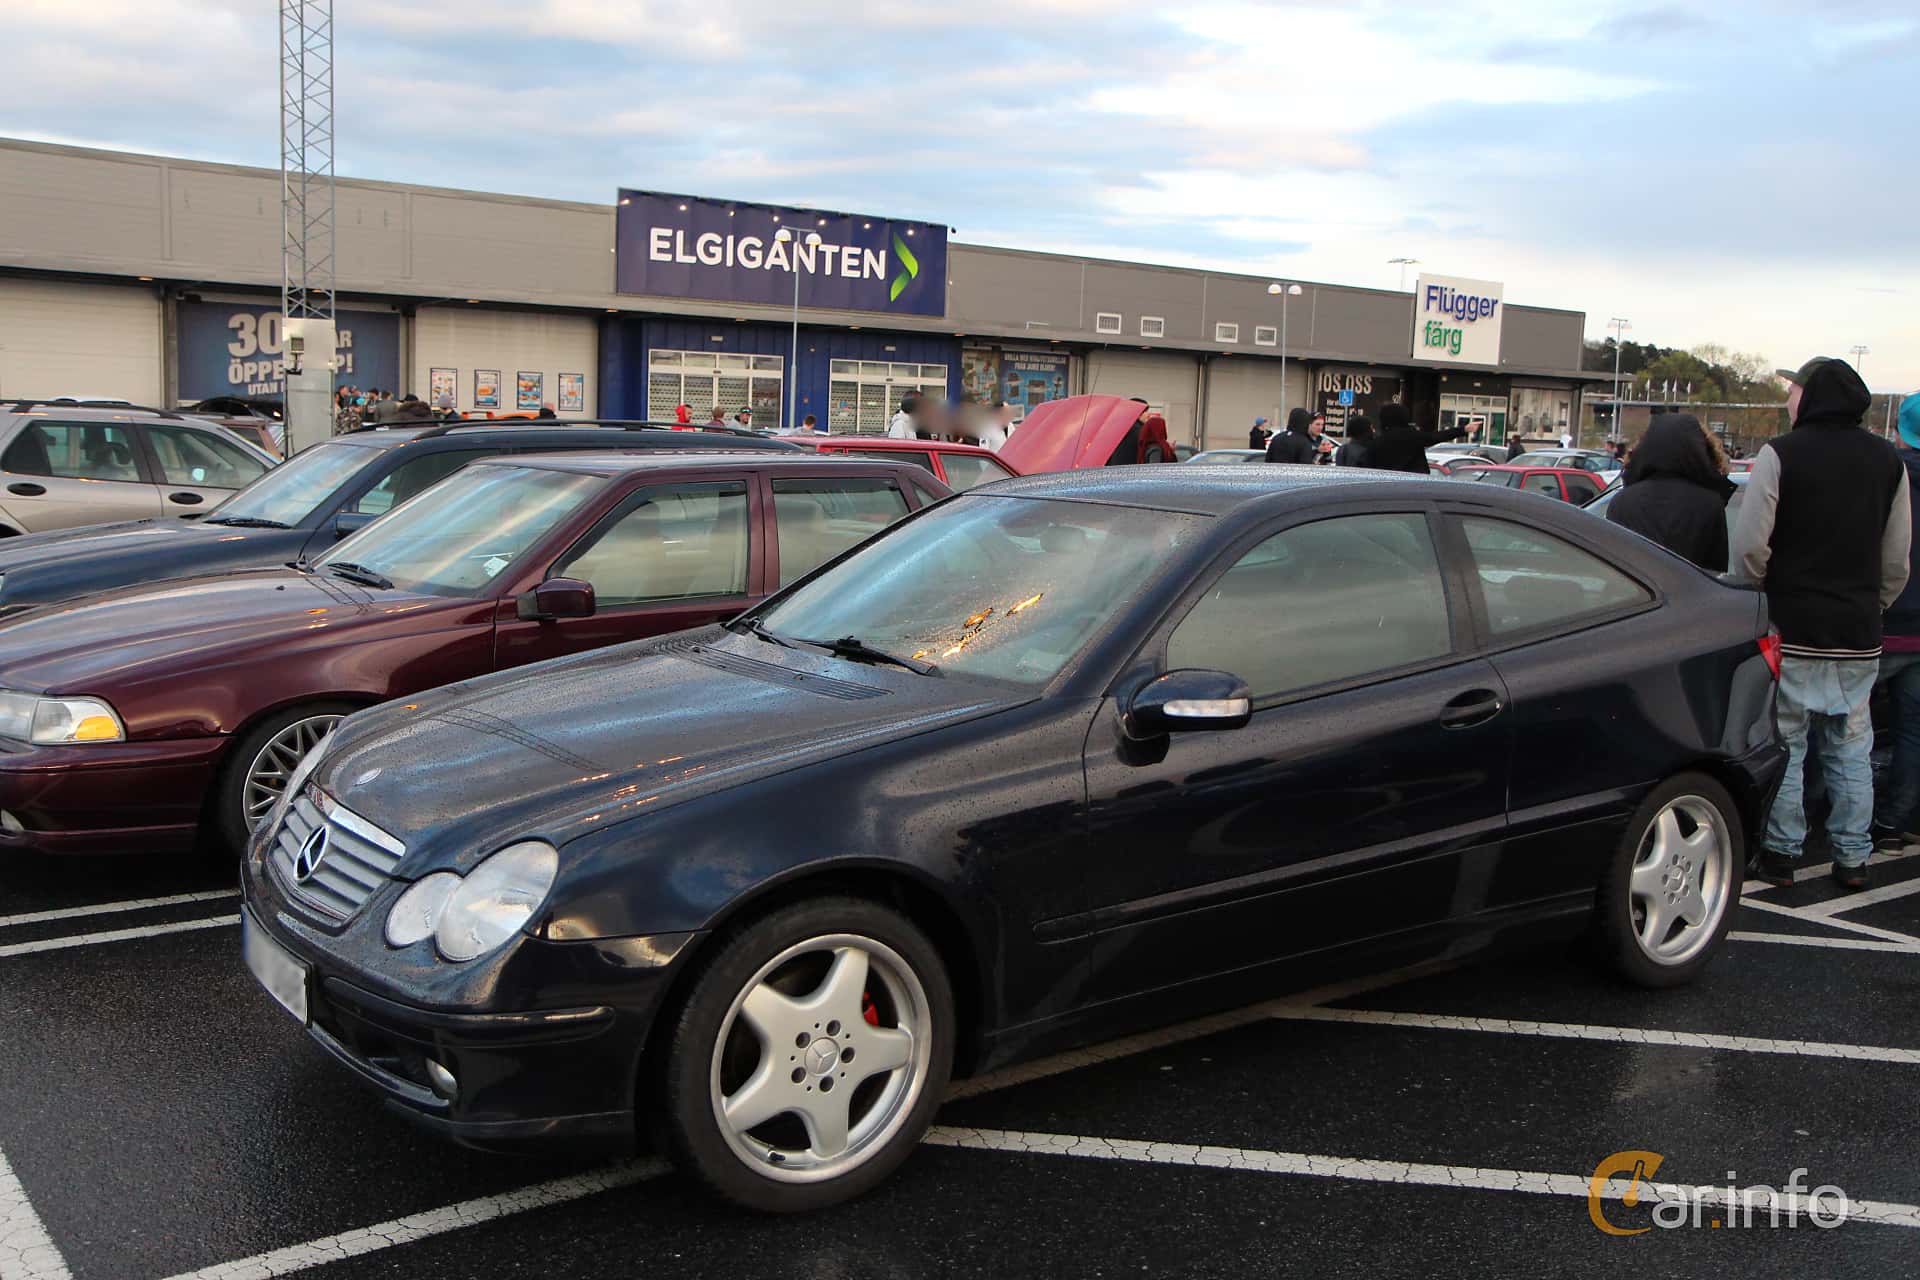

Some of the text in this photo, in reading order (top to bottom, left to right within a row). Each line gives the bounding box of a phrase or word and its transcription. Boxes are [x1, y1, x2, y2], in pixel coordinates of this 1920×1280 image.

[649, 227, 886, 281] ELGIGANTEN
[1426, 285, 1498, 322] Flügger
[1424, 320, 1463, 355] färg
